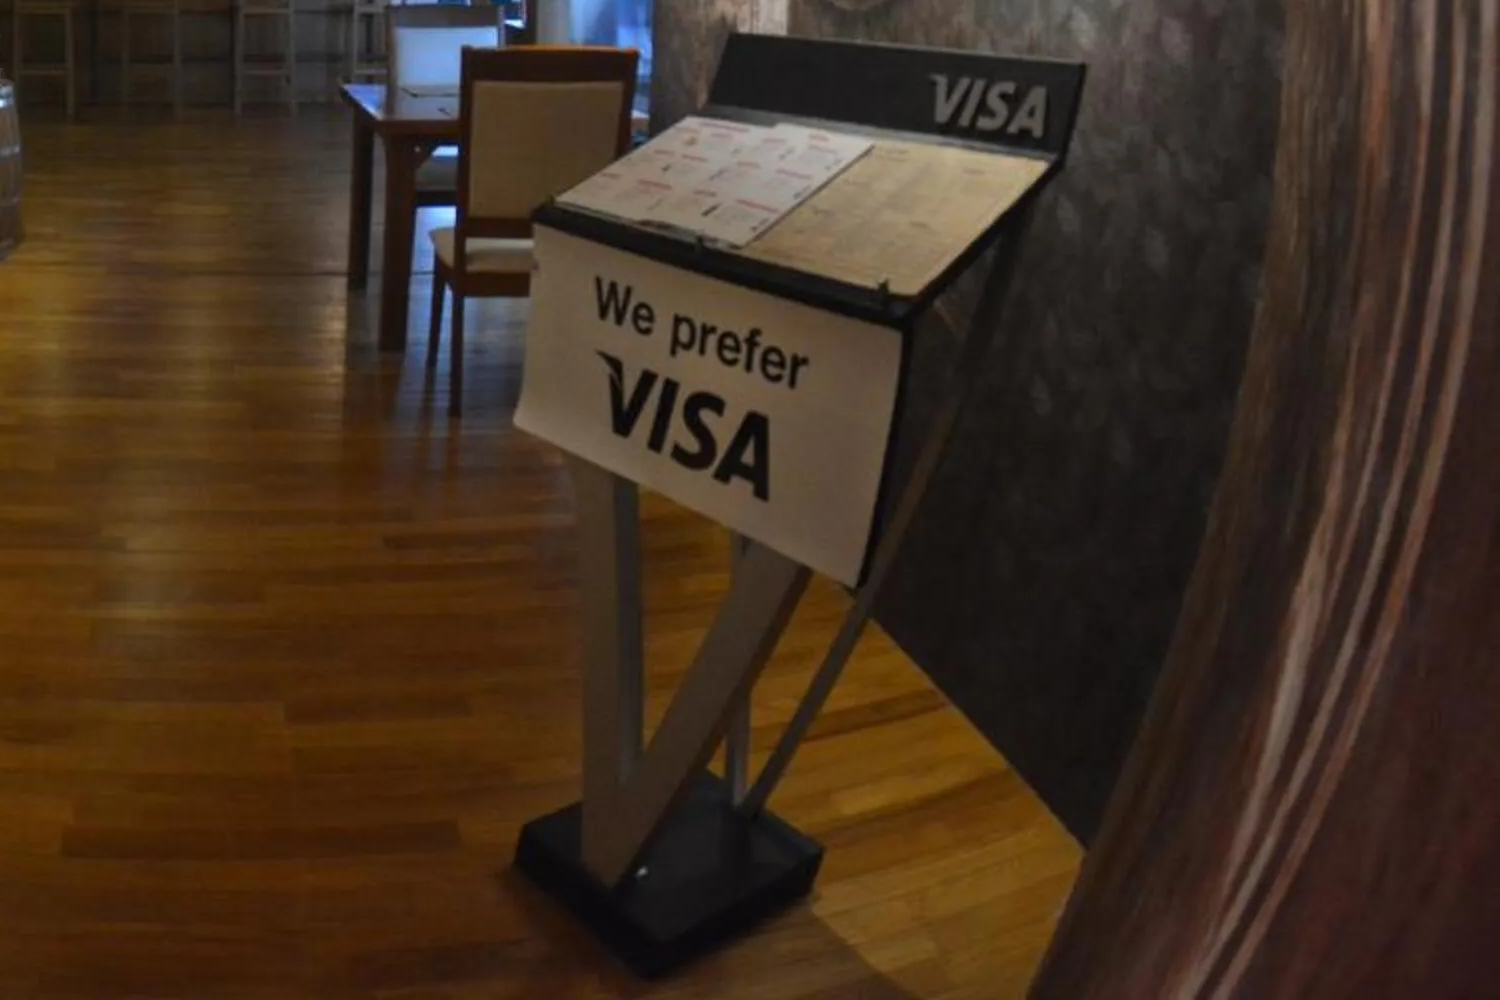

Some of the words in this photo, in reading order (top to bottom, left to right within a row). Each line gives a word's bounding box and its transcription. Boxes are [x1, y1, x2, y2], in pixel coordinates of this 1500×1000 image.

[928, 73, 1049, 139] VISA
[594, 275, 655, 337] We
[669, 308, 810, 389] prefer
[595, 350, 771, 502] VISA
